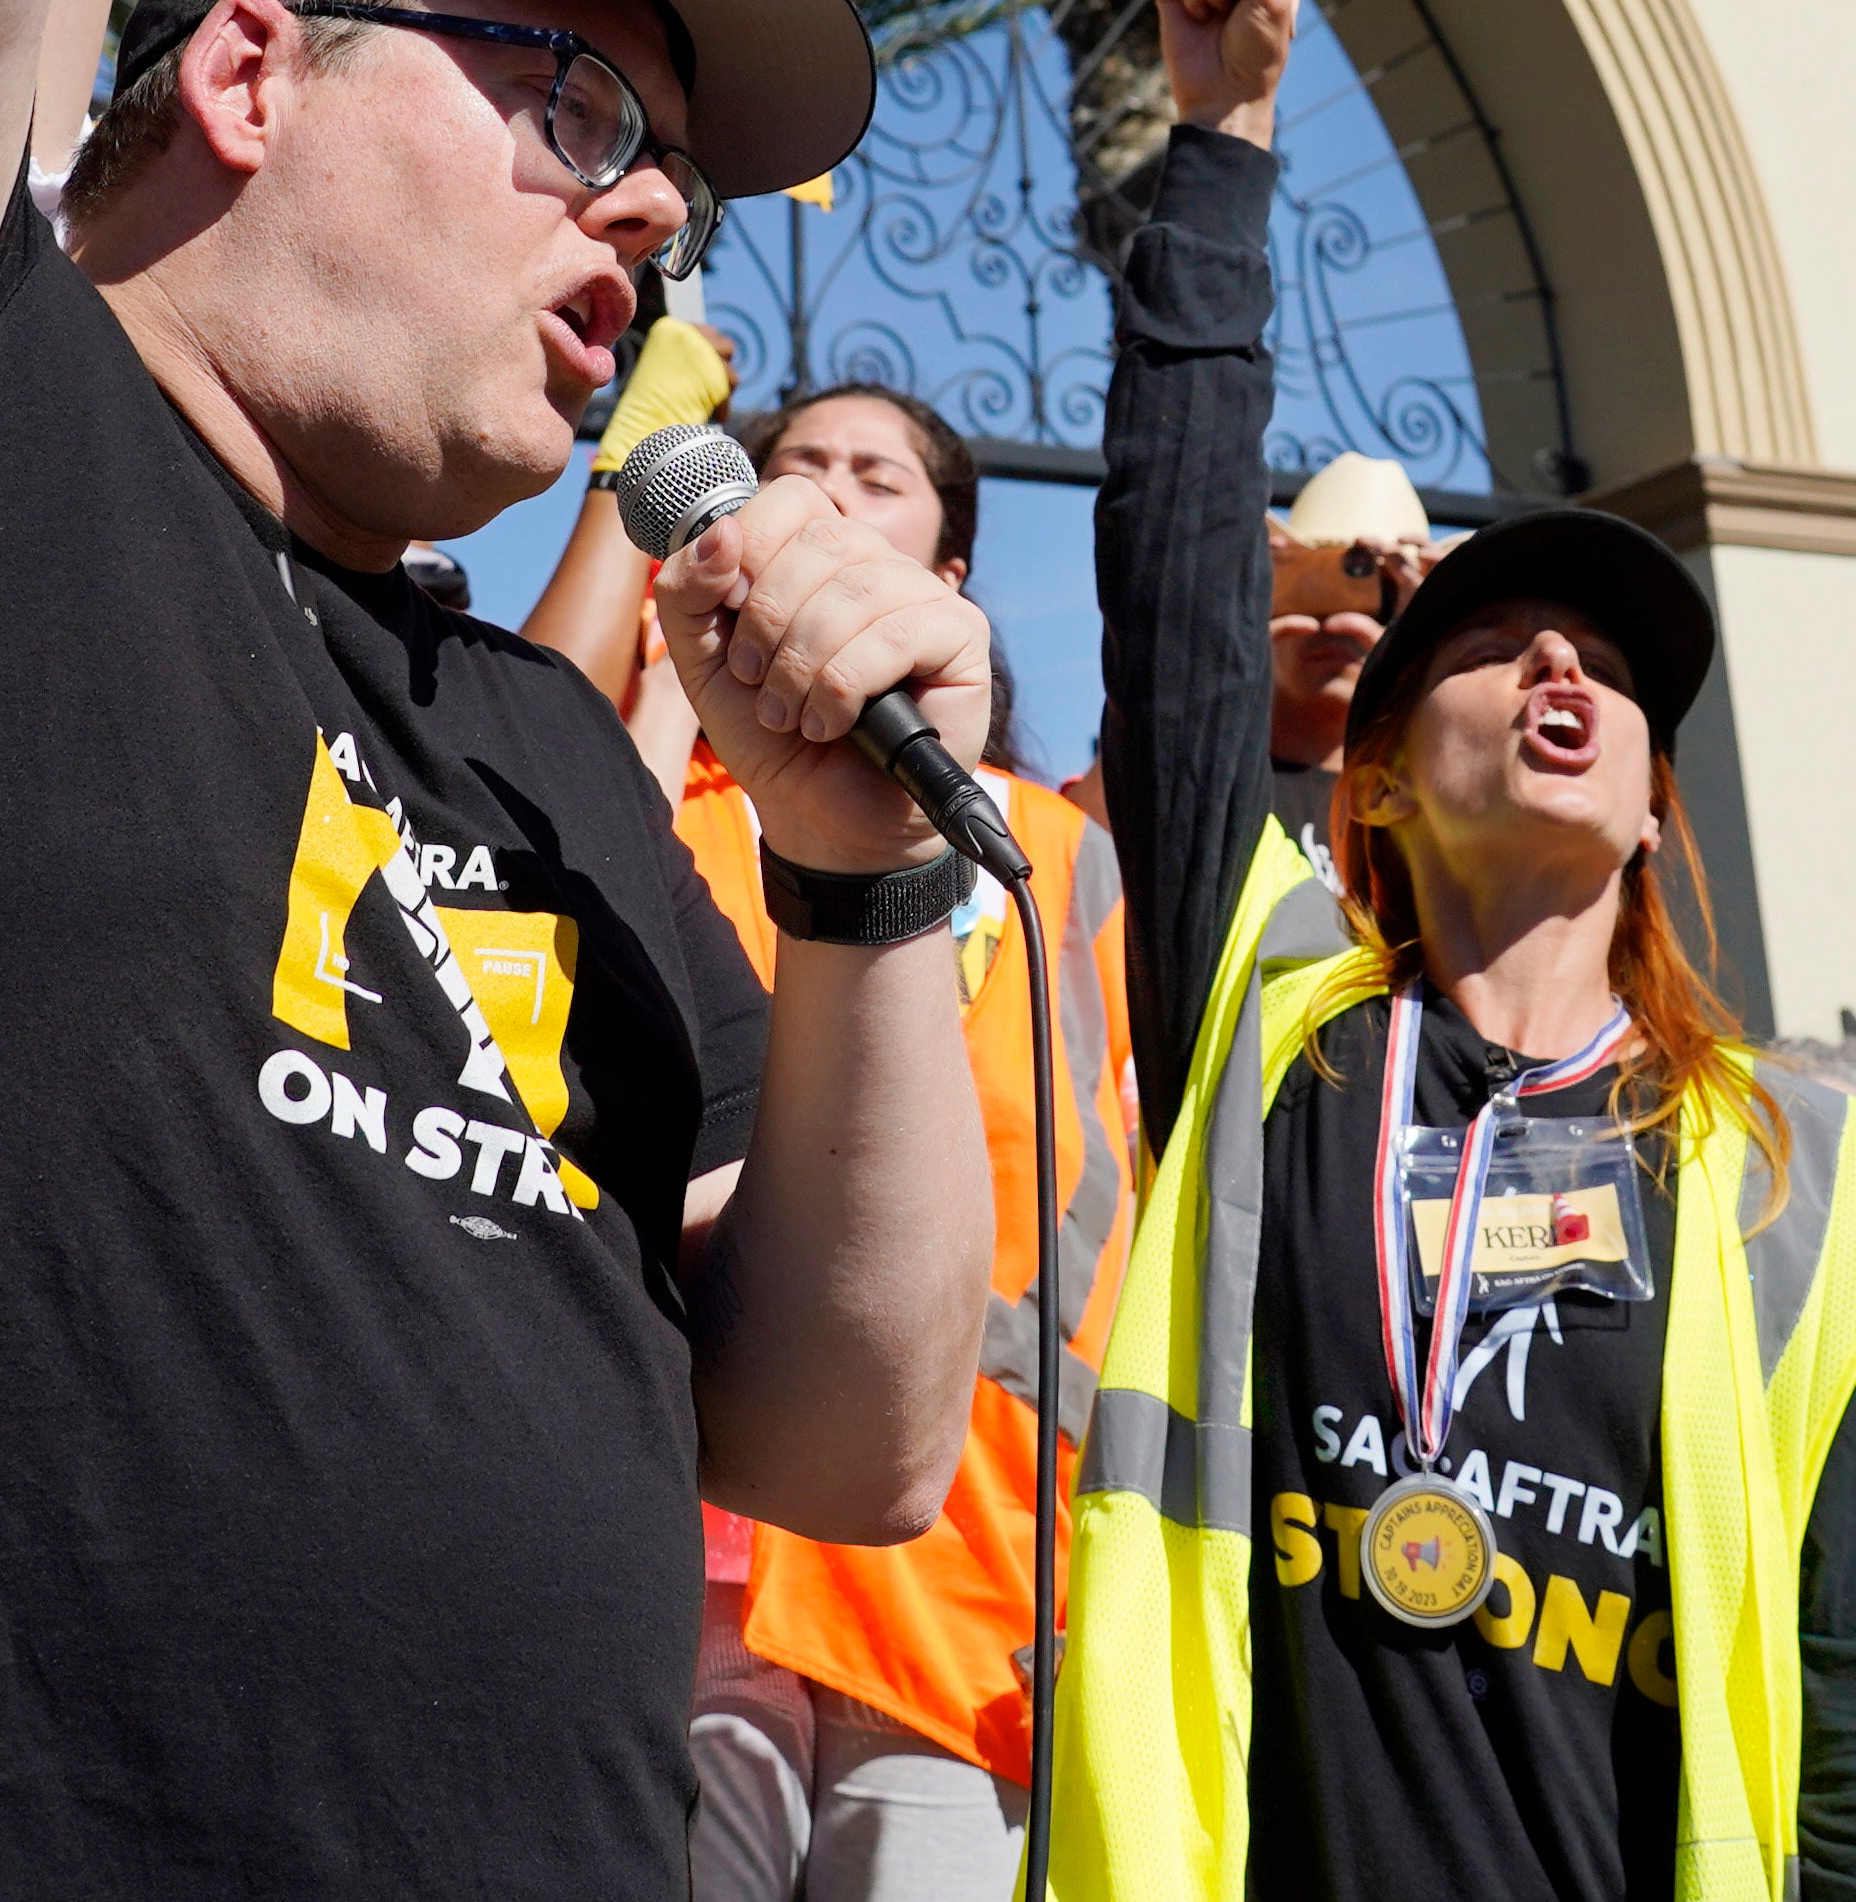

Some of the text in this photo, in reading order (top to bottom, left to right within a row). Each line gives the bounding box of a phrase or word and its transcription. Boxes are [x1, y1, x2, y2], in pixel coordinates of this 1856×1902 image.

[482, 959, 532, 978] PAUSE
[258, 1049, 585, 1223] ON STR
[1380, 1500, 1479, 1598] CAPTAINS APPRECIATION DAY
